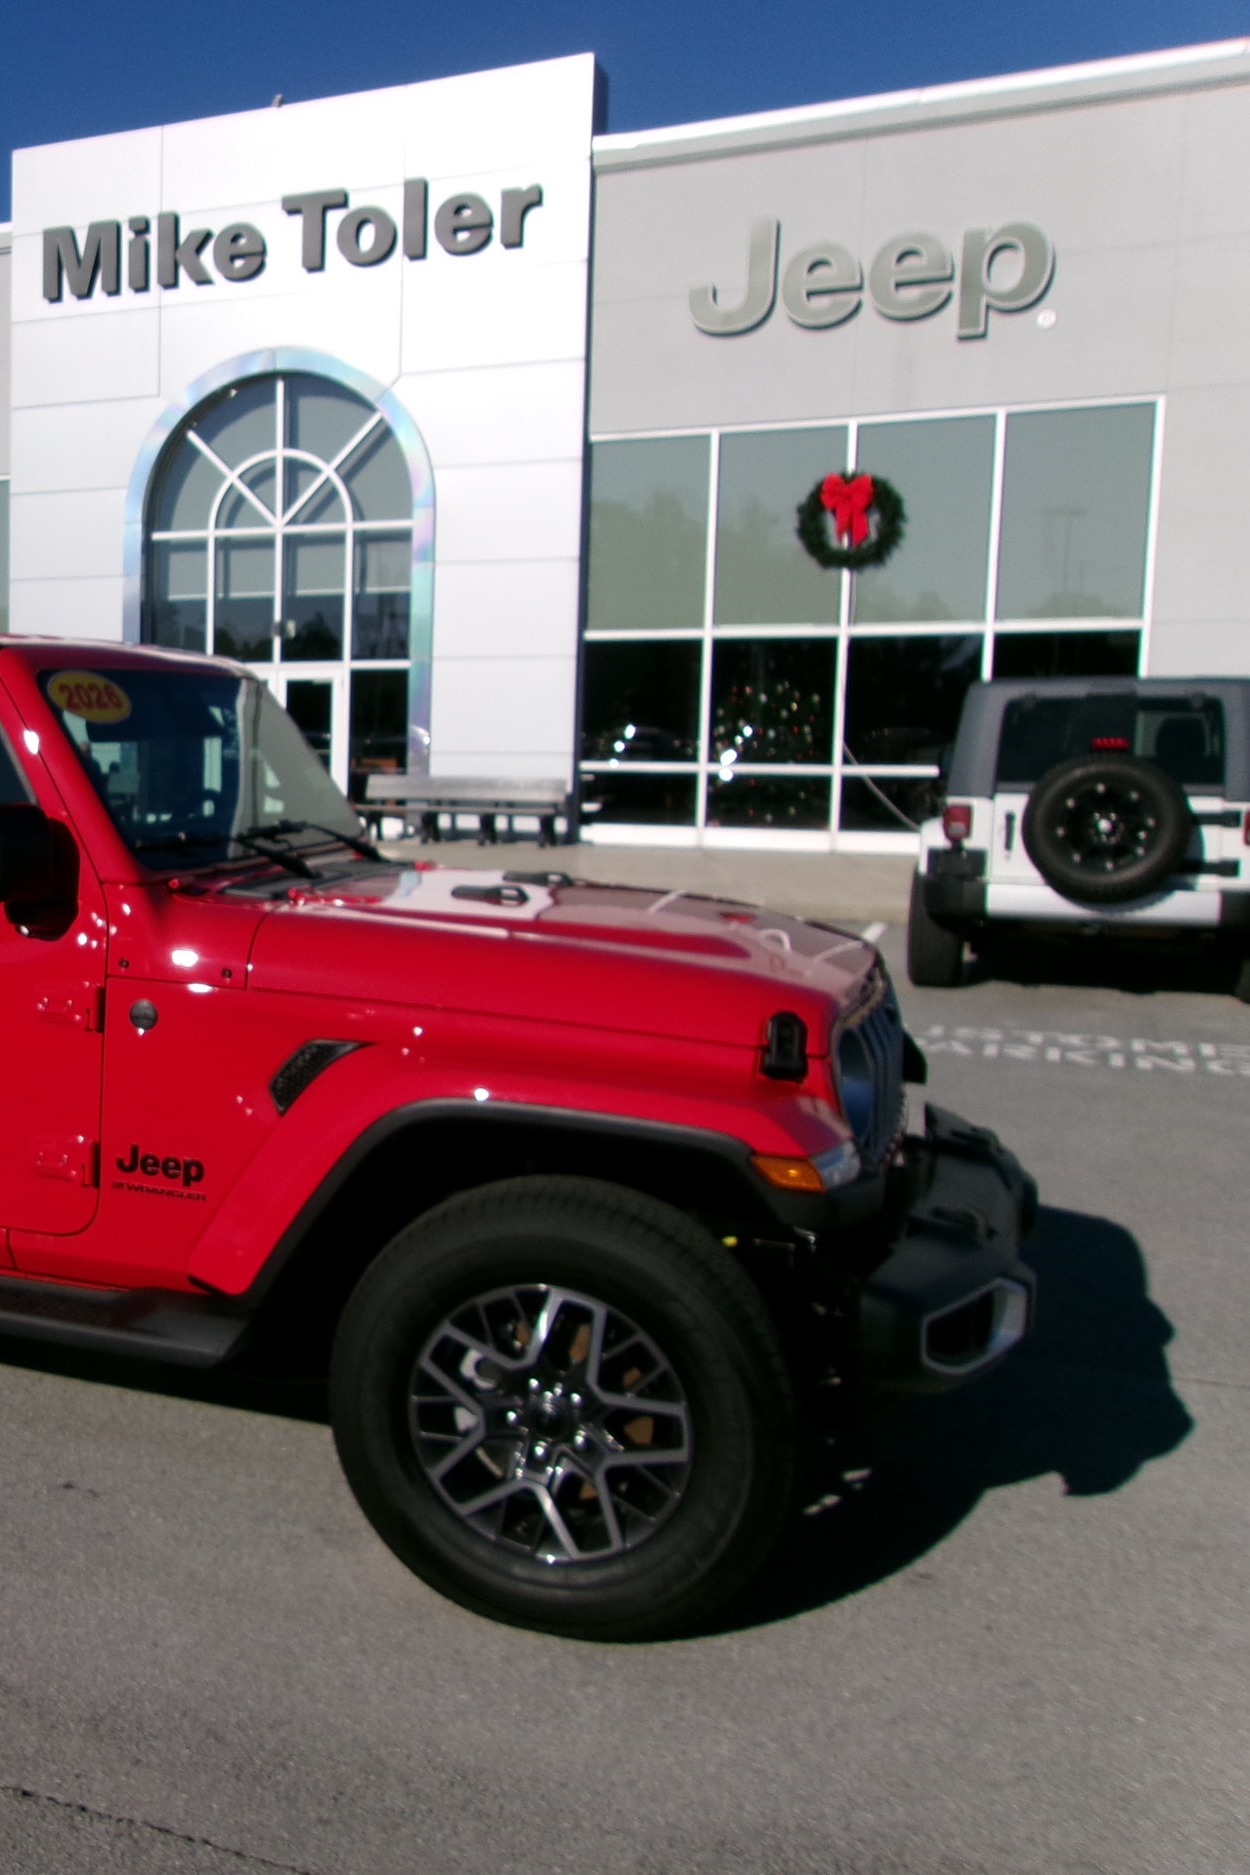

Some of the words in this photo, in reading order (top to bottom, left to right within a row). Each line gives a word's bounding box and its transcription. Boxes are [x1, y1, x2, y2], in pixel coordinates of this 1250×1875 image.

[42, 211, 267, 304] Mike
[281, 176, 544, 273] Toler
[688, 214, 1056, 341] Jeep
[115, 1144, 205, 1187] Jeep
